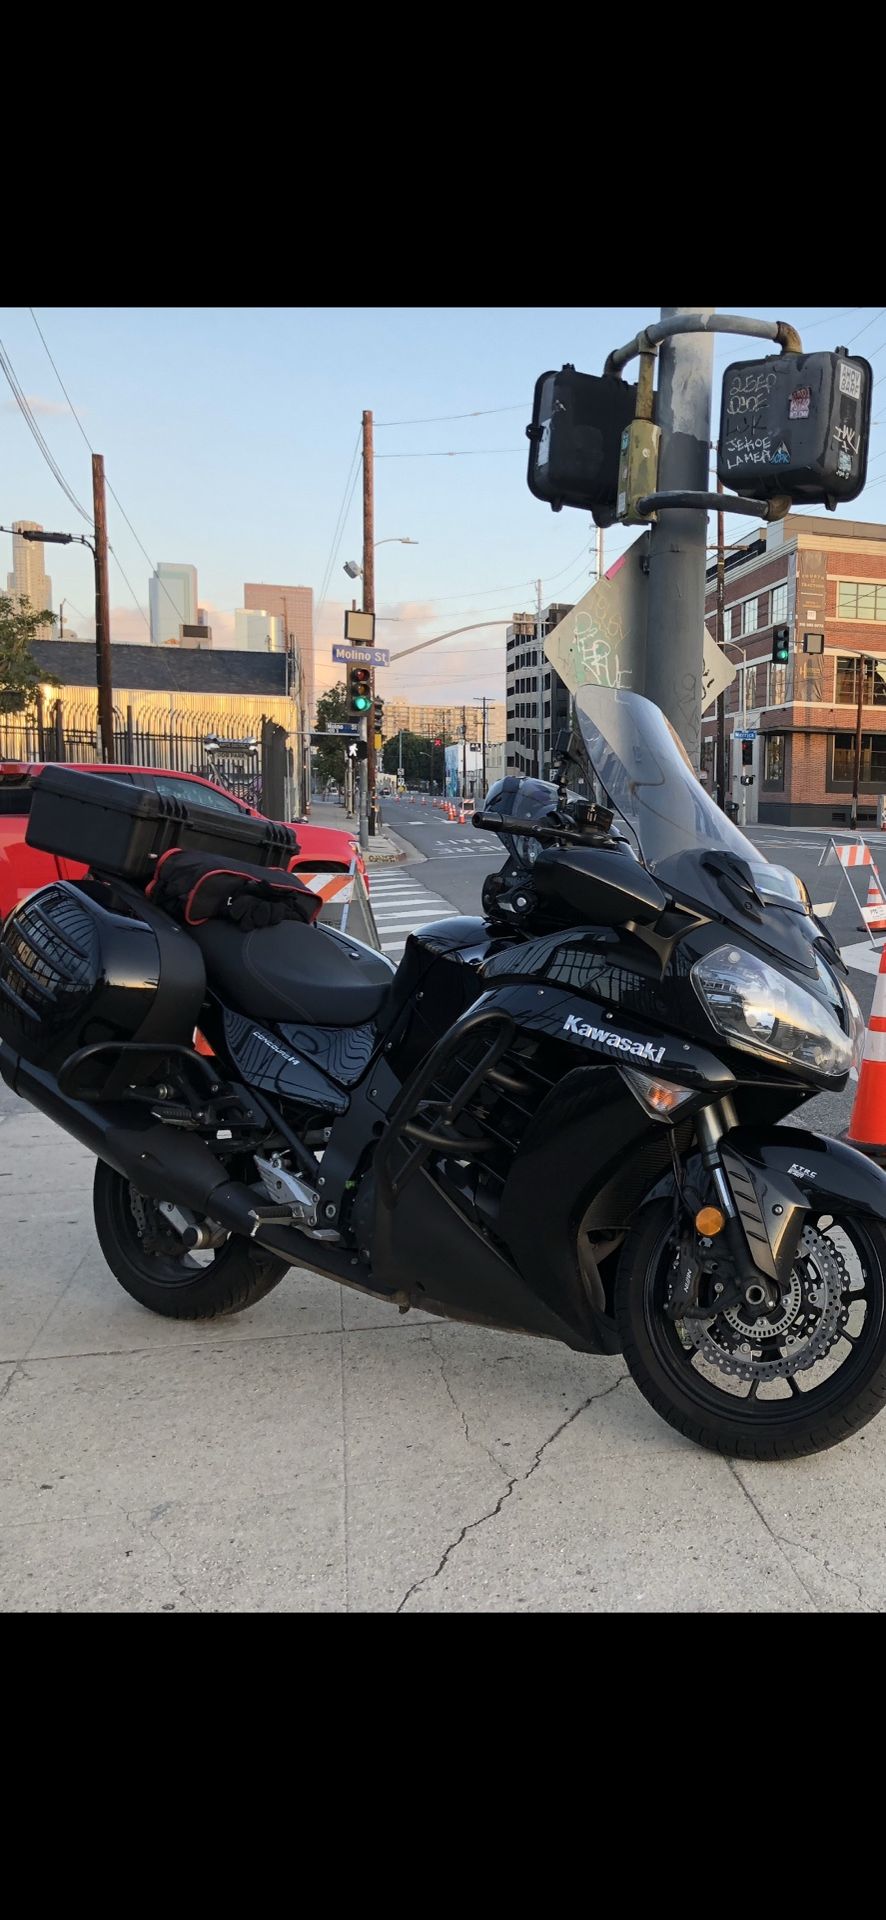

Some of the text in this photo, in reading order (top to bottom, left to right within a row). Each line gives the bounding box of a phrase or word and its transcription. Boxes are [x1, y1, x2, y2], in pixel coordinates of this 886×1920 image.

[841, 378, 859, 394] BARF
[336, 648, 387, 662] Molino St
[563, 1014, 666, 1064] Kawasaki
